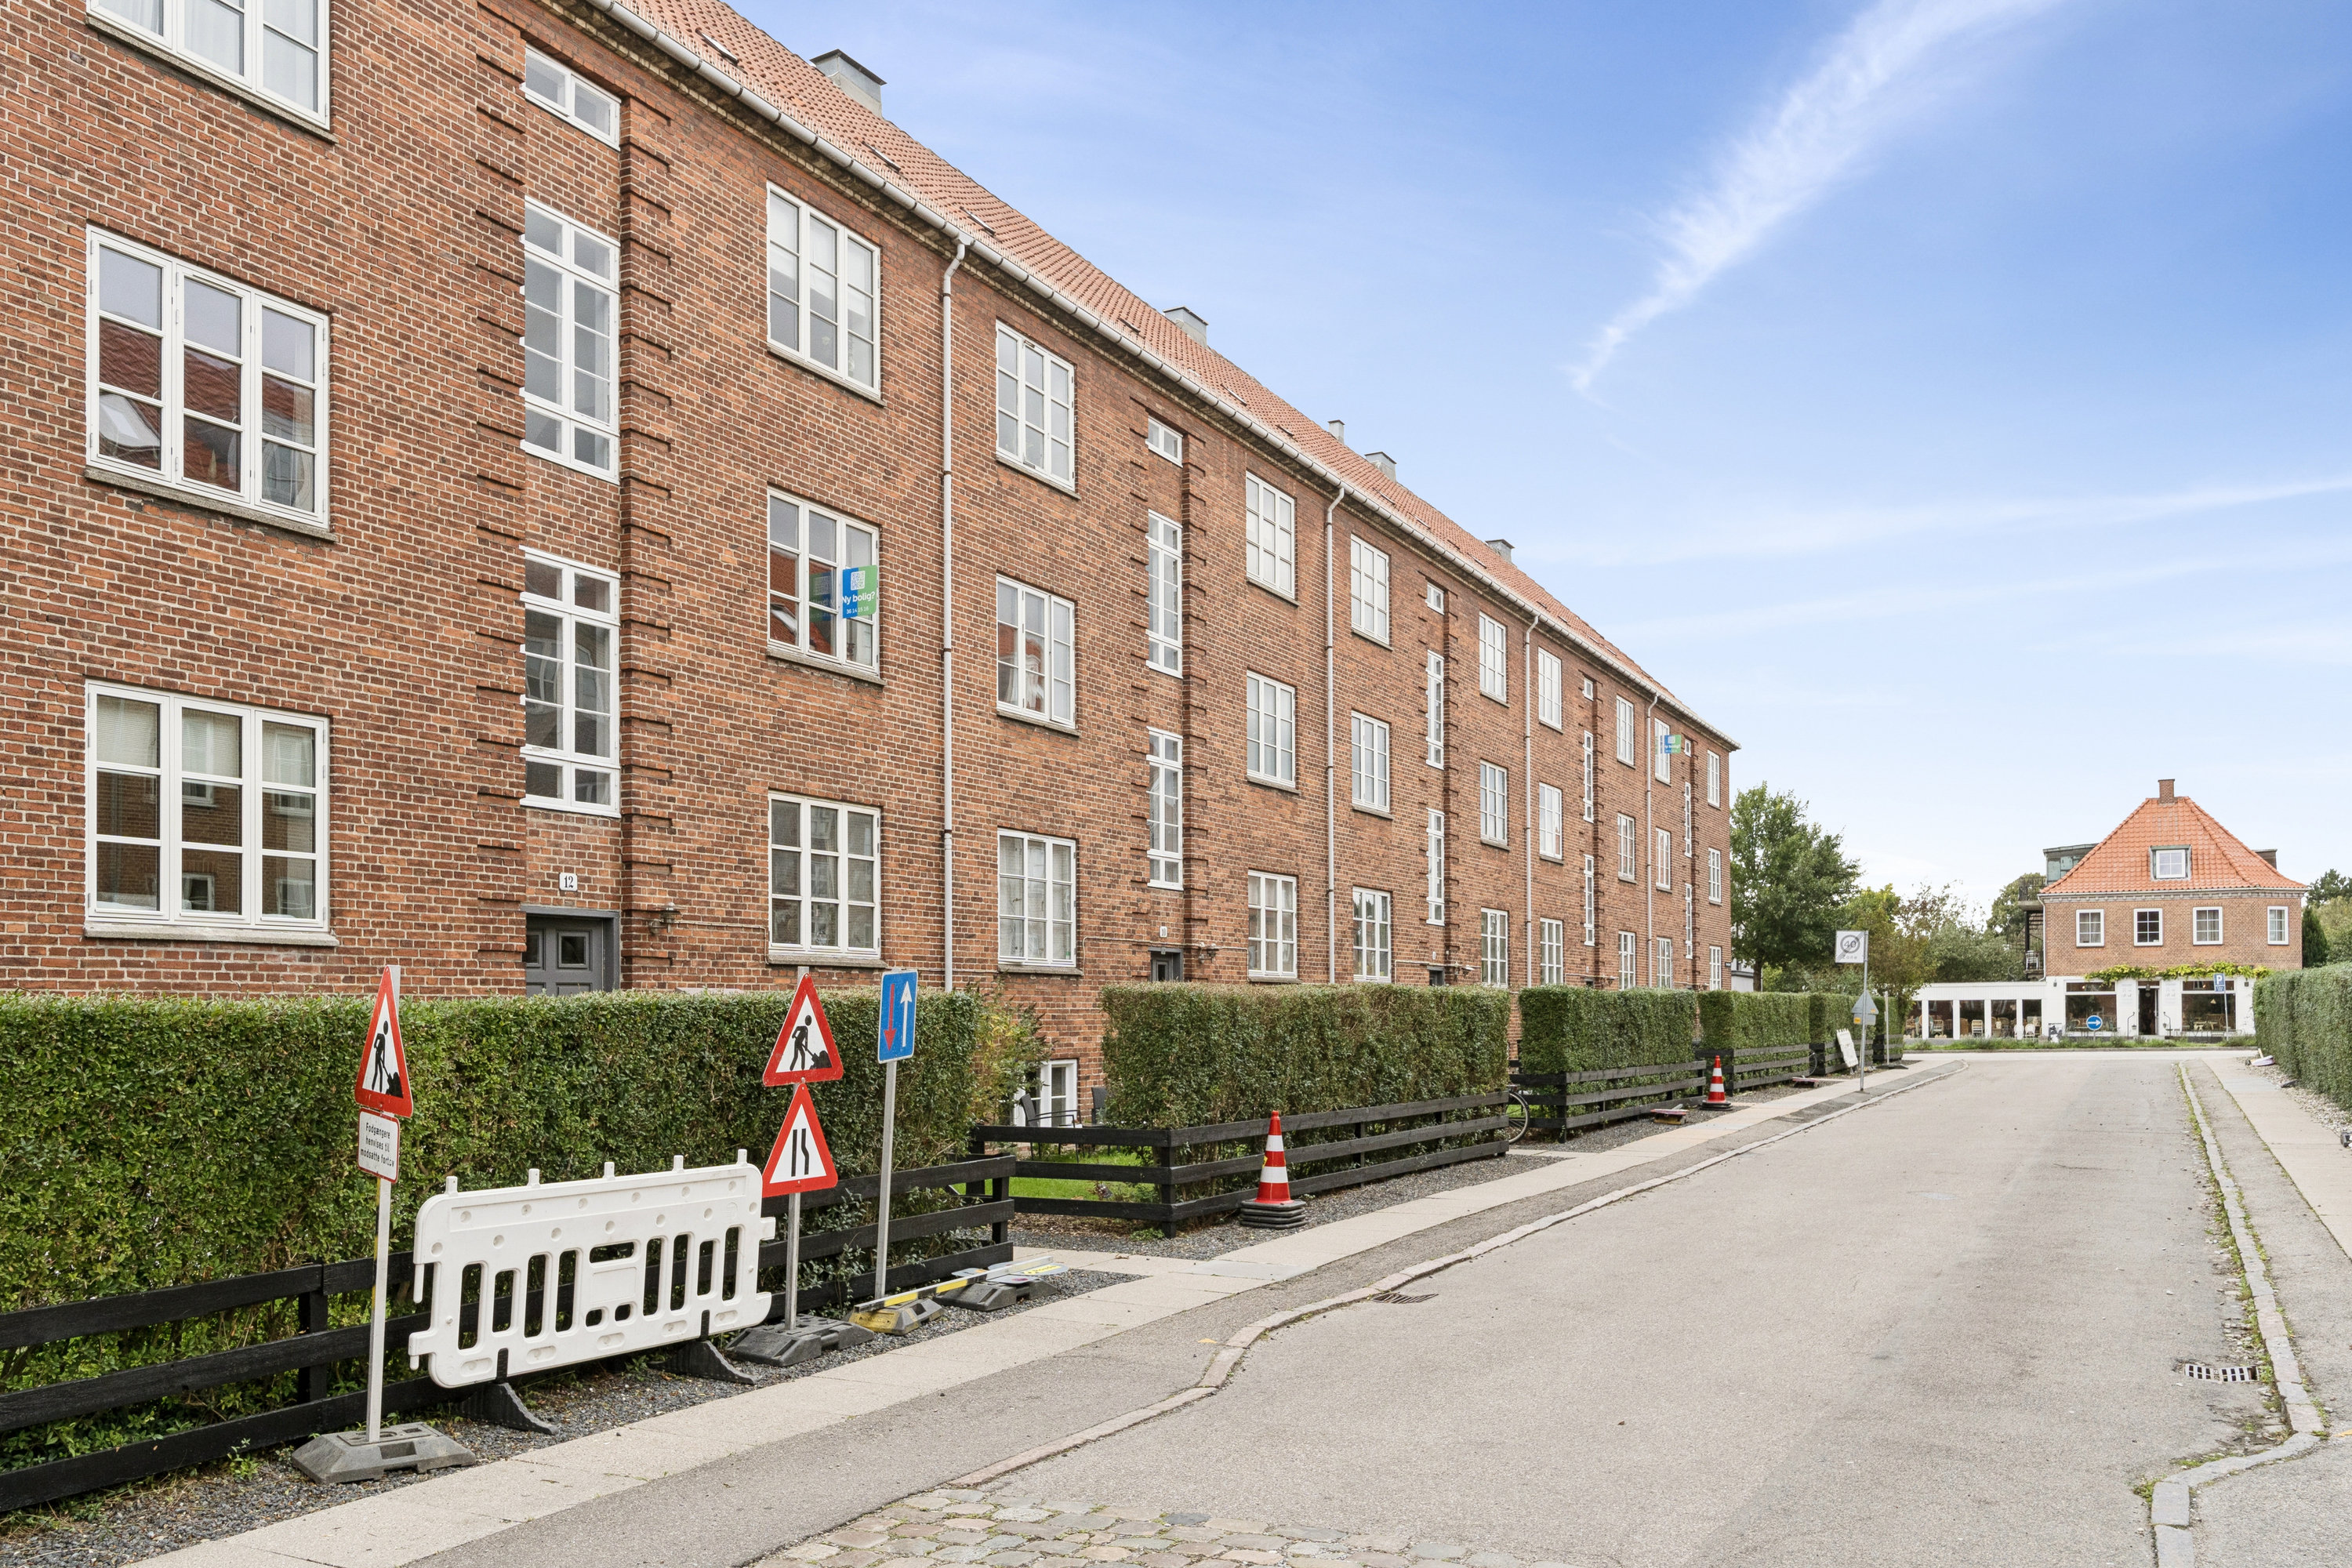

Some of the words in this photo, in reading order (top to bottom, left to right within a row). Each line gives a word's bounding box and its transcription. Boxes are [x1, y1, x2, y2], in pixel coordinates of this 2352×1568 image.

[842, 596, 851, 604] Ny
[852, 591, 875, 602] bolig?
[564, 875, 574, 888] 12
[2216, 975, 2223, 985] P
[365, 1122, 390, 1139] Fodgængere
[365, 1135, 383, 1150] henvises
[361, 1149, 380, 1162] modsatte
[380, 1154, 395, 1167] fortov
